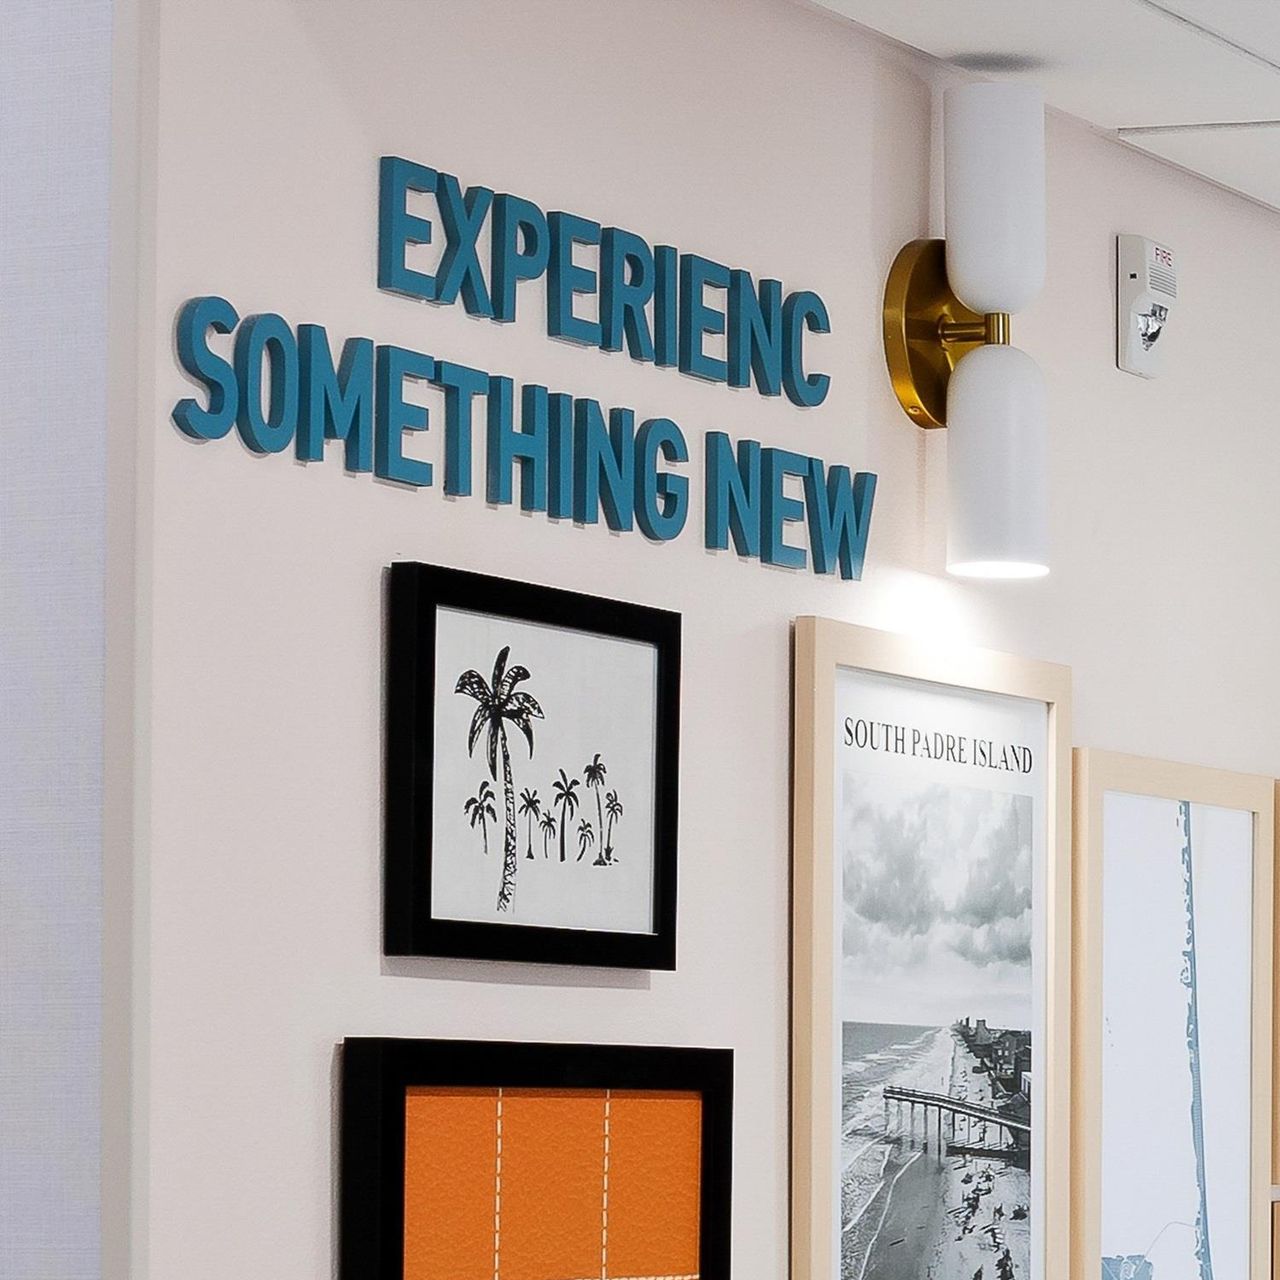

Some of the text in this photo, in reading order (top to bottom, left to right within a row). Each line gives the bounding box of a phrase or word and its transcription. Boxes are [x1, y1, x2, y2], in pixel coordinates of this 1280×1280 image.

[378, 155, 832, 407] EXPERIENC
[172, 295, 878, 581] SOMETHING NEW
[844, 717, 1033, 774] SOUTH PADRE ISLAND
